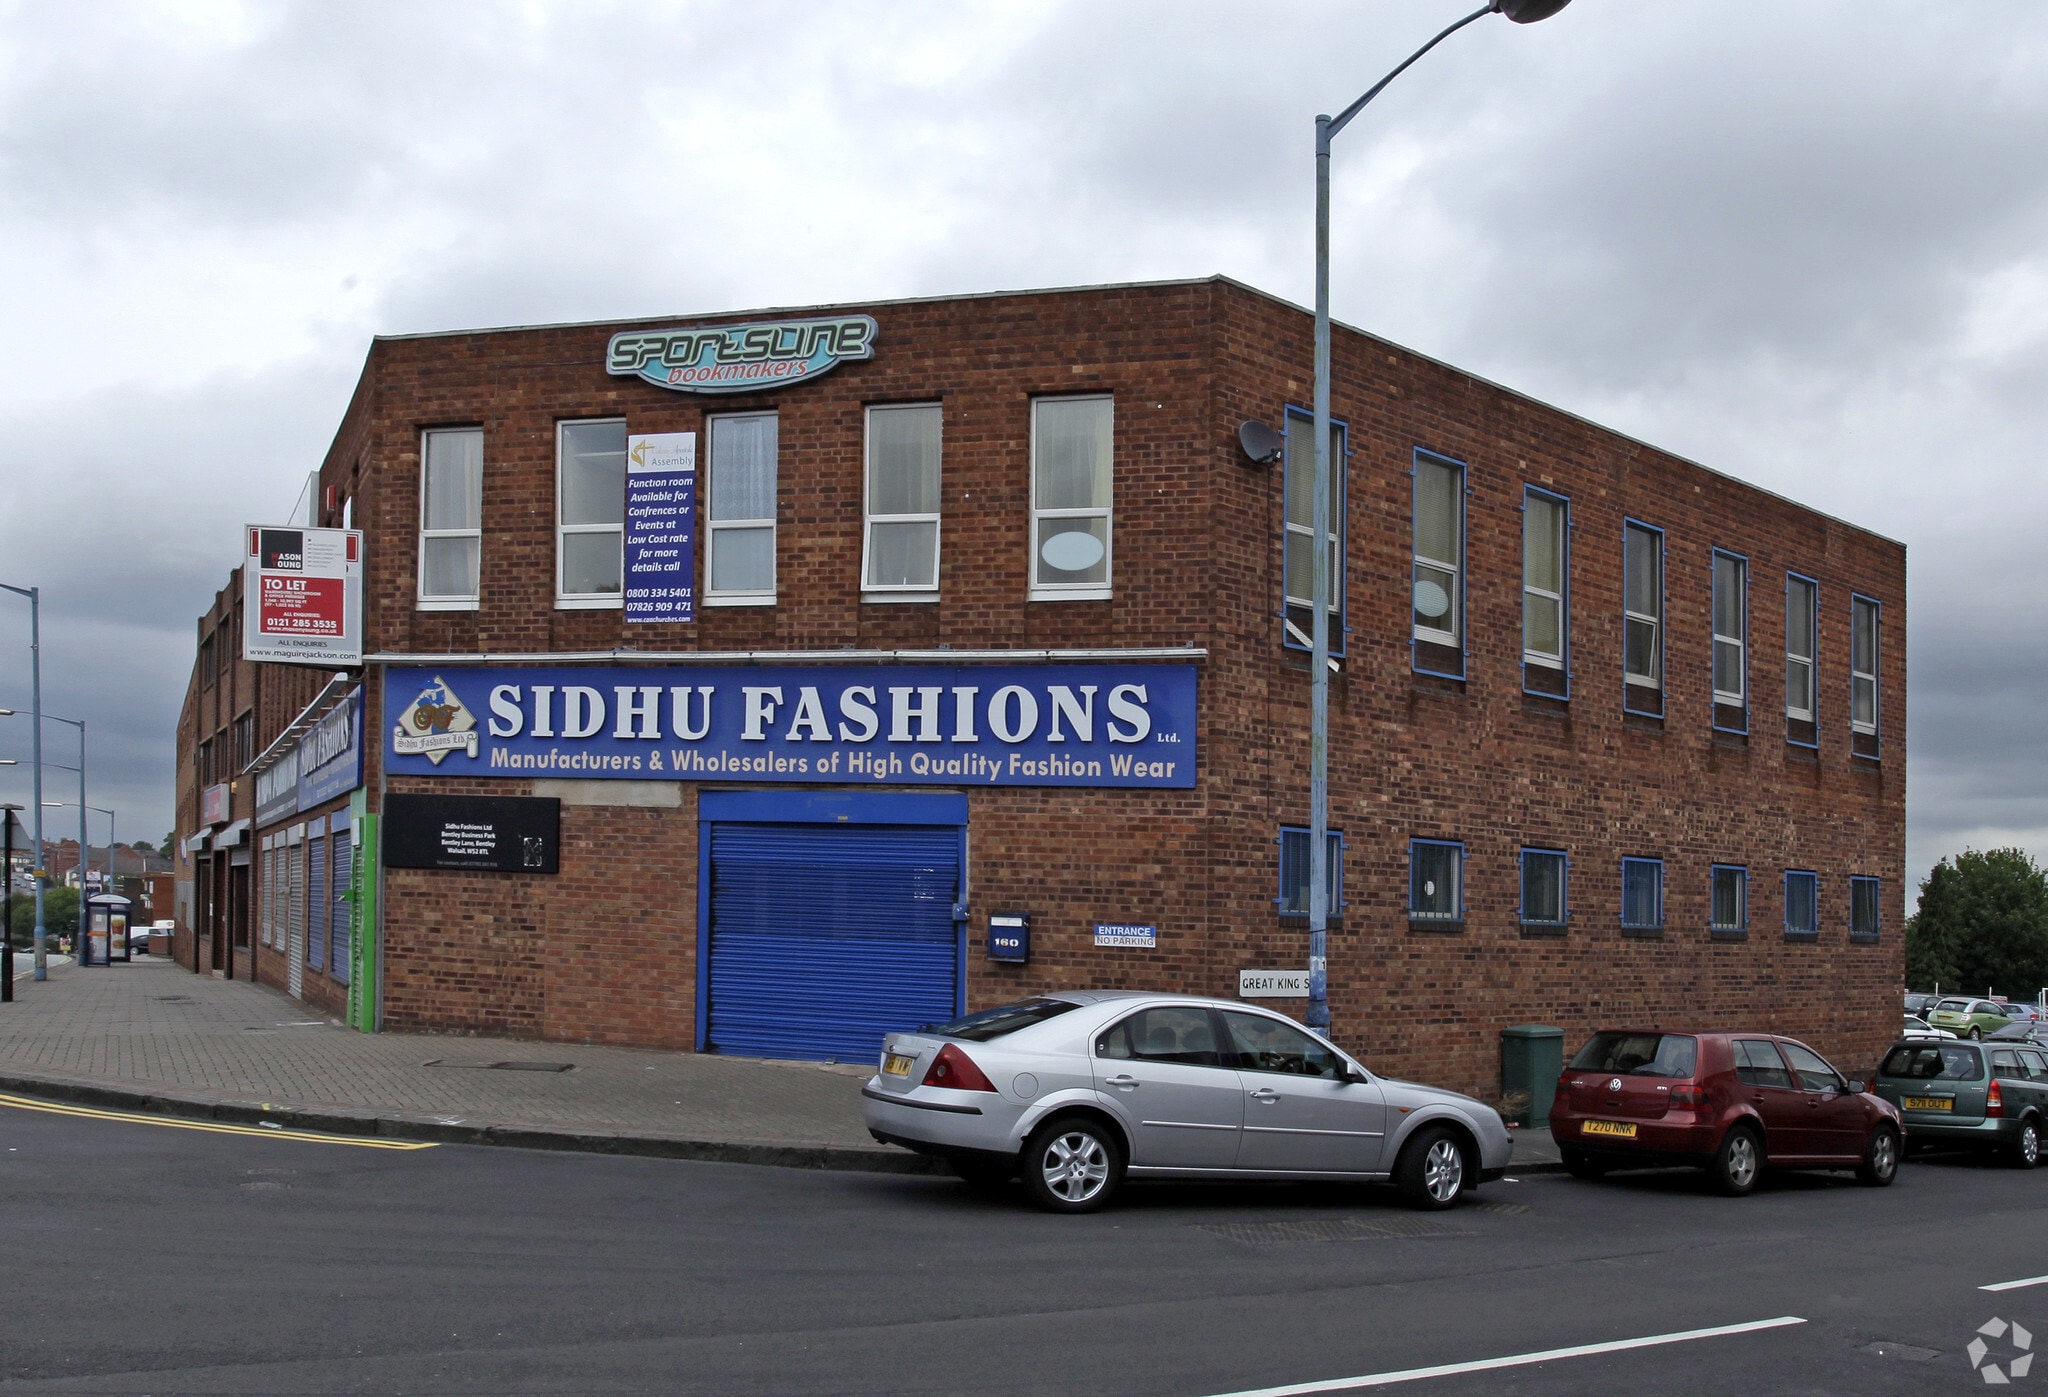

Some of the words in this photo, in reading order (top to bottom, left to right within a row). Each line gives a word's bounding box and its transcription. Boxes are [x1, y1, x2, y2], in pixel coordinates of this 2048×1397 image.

[667, 360, 808, 384] bookmakers
[651, 456, 693, 466] Assembly
[628, 479, 667, 488] Function
[668, 478, 693, 486] room
[630, 492, 672, 502] Available
[673, 490, 688, 502] for
[628, 506, 677, 518] Confrences
[679, 506, 689, 514] or
[635, 520, 664, 530] Events
[666, 521, 676, 529] at
[628, 536, 646, 544] Low
[648, 534, 668, 544] Cost
[669, 534, 688, 542] rate
[271, 553, 301, 561] MASON
[638, 548, 653, 560] for
[654, 549, 678, 557] more
[632, 562, 662, 572] details
[664, 561, 680, 571] call
[264, 579, 283, 590] TO
[286, 580, 307, 590] LET
[626, 589, 649, 598] 0800
[650, 588, 667, 597] 334
[669, 588, 691, 597] 5401
[626, 602, 653, 611] 07826
[655, 602, 672, 611] 909
[675, 602, 691, 611] 471
[267, 618, 289, 626] 0121
[293, 619, 310, 627] 285
[313, 620, 337, 628] 3535
[249, 649, 357, 660] www.maguirejackson.com
[488, 684, 715, 740] SIDHU
[741, 684, 1151, 743] FASHIONS
[1157, 732, 1181, 743] Ltd.
[490, 748, 641, 770] Manufacturers
[649, 751, 664, 771] &
[671, 750, 808, 773] Wholesalers
[817, 751, 839, 773] of
[848, 751, 902, 779] High
[910, 752, 1002, 781] Quality
[1009, 753, 1101, 777] Fashion
[1110, 754, 1176, 778] Wear
[476, 840, 496, 848] Bentley
[1098, 927, 1151, 936] ENTRANCE
[994, 938, 1019, 947] 160
[1097, 936, 1110, 945] NO
[1113, 937, 1154, 946] PARKING
[1242, 978, 1274, 989] GREAT
[1277, 978, 1299, 989] KING
[1304, 978, 1310, 989] S
[1586, 1120, 1611, 1132] T270
[1613, 1123, 1634, 1134] NNK
